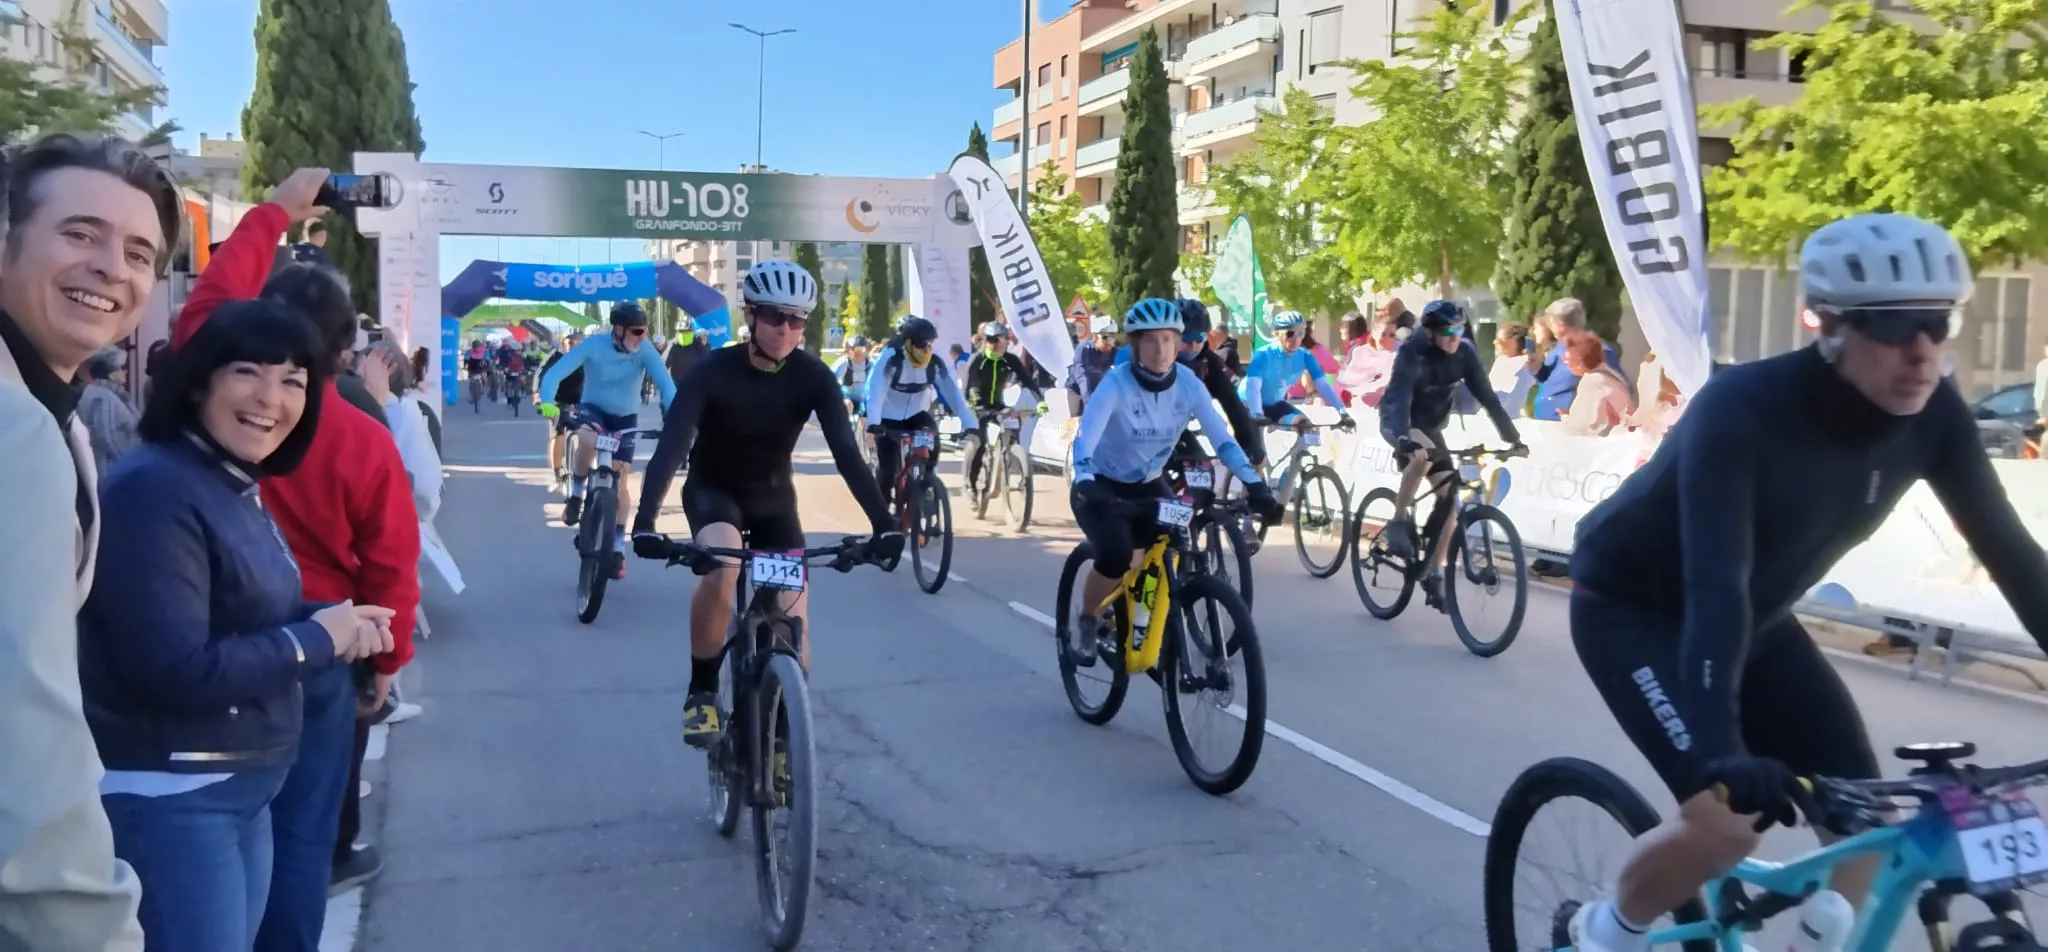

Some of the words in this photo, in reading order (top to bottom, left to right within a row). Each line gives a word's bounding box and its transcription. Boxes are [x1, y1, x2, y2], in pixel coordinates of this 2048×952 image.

[1587, 48, 1689, 276] GOBIK
[626, 179, 749, 218] HU-108
[887, 203, 931, 217] VICKY
[991, 223, 1050, 328] GOBIK
[1163, 506, 1190, 521] 1056
[758, 562, 800, 579] 1114
[1631, 665, 1692, 751] BIKERS
[1980, 831, 2040, 865] 193
